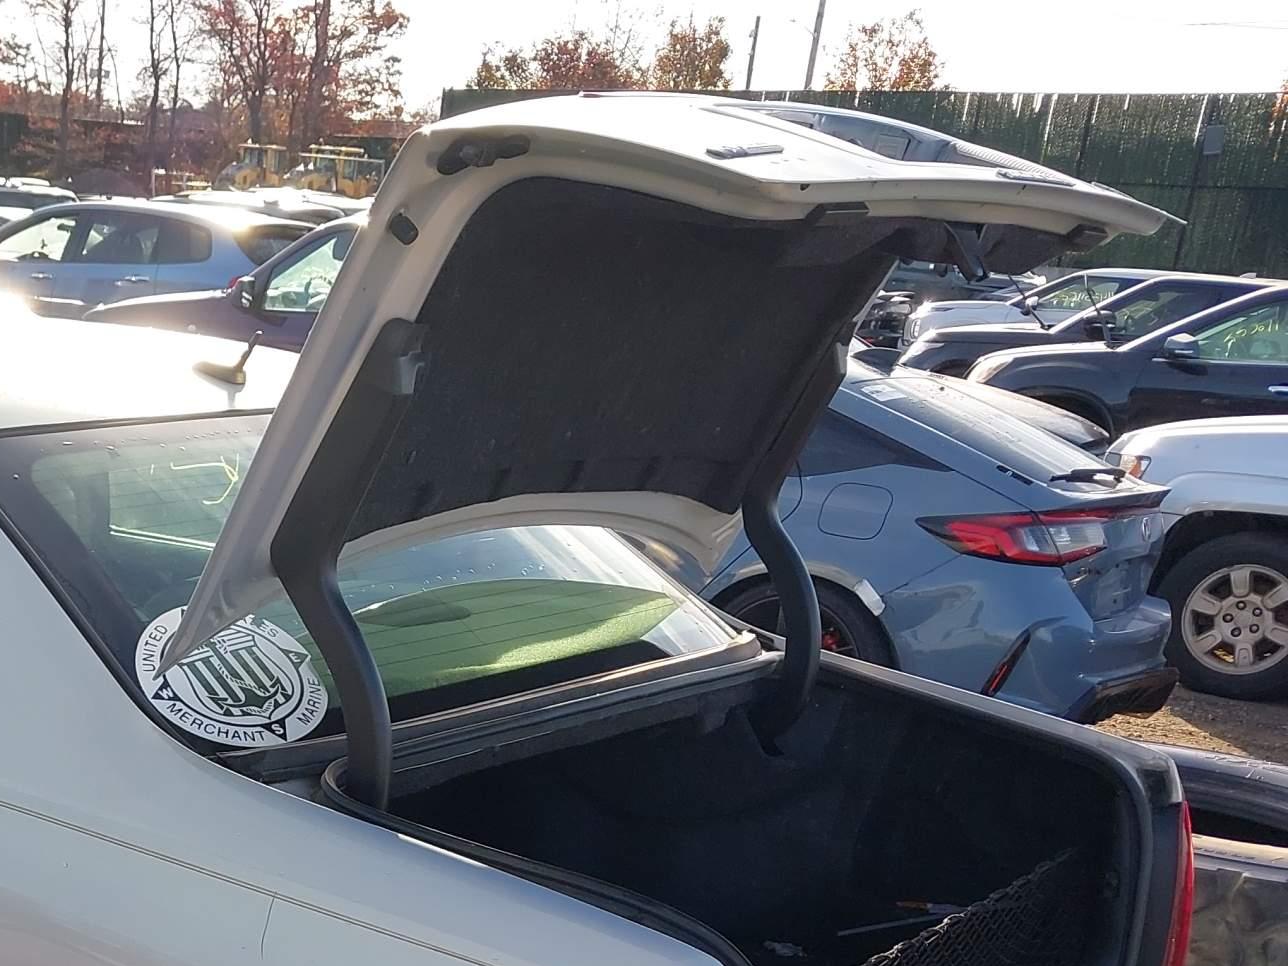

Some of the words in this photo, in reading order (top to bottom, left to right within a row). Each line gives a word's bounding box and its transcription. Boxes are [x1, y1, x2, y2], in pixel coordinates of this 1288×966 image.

[142, 624, 168, 672] UNITED
[166, 702, 265, 742] MERCHANT
[296, 677, 323, 726] MARINE
